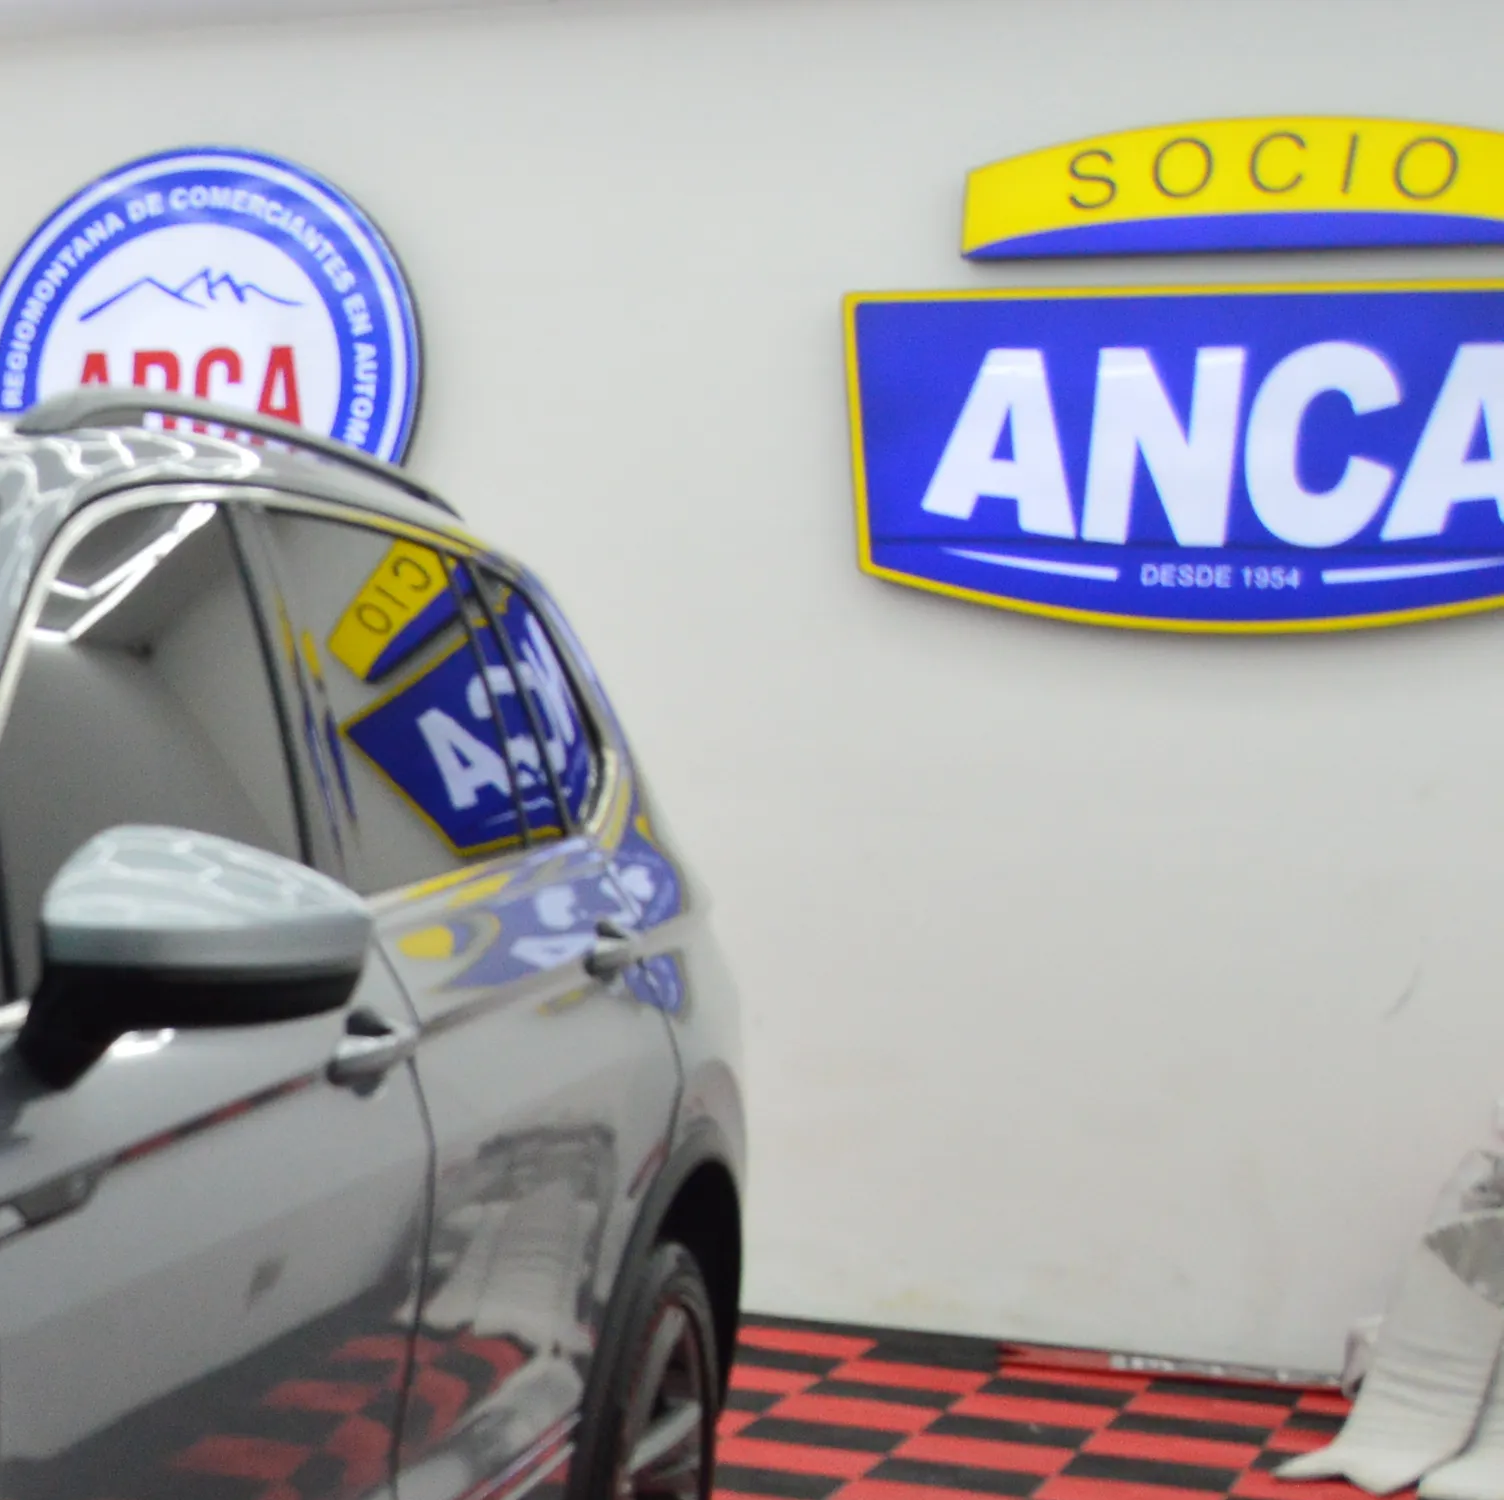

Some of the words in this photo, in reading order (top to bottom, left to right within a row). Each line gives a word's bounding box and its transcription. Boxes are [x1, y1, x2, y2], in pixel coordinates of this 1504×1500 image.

[1067, 130, 1460, 210] SOCIO
[0, 211, 126, 409] REGIOMONTANA
[124, 191, 165, 225] DE
[168, 184, 357, 294] COMERCIANTES
[342, 292, 374, 337] EN
[920, 339, 1504, 549] ANCA
[1140, 562, 1232, 588] DESDE
[1242, 565, 1302, 590] 1954
